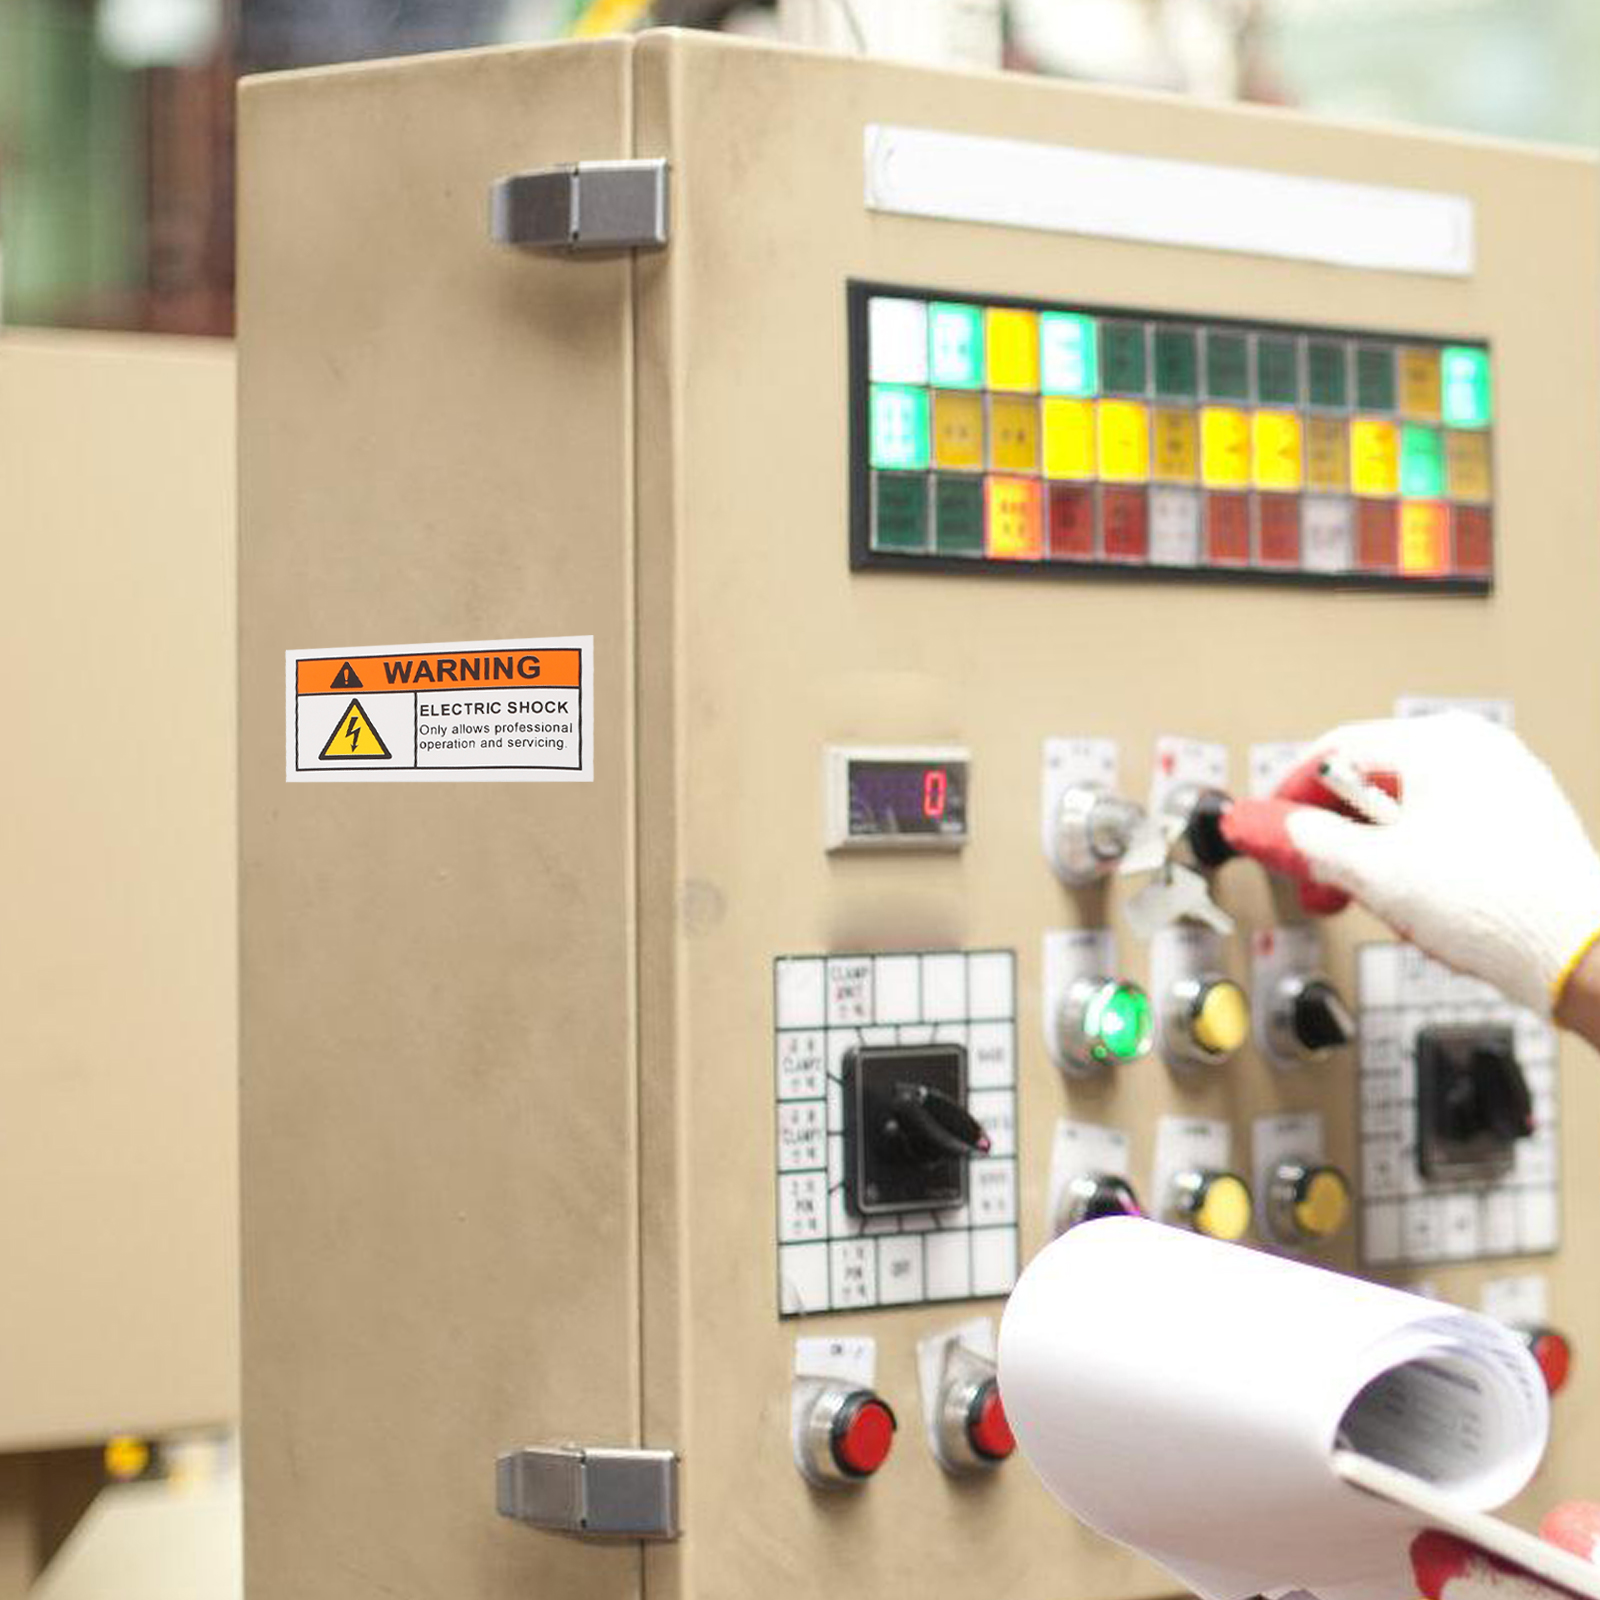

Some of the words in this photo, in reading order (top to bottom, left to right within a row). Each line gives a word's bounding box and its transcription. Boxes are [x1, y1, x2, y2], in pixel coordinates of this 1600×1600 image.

[383, 655, 541, 685] WARNING
[419, 702, 502, 717] ELECTRIC
[507, 701, 569, 715] SHOCK
[419, 723, 448, 738] Only
[451, 723, 491, 735] allows
[494, 722, 574, 737] professional
[419, 738, 476, 751] operation
[480, 738, 503, 749] and
[507, 737, 569, 751] servicing.
[924, 770, 947, 818] 0
